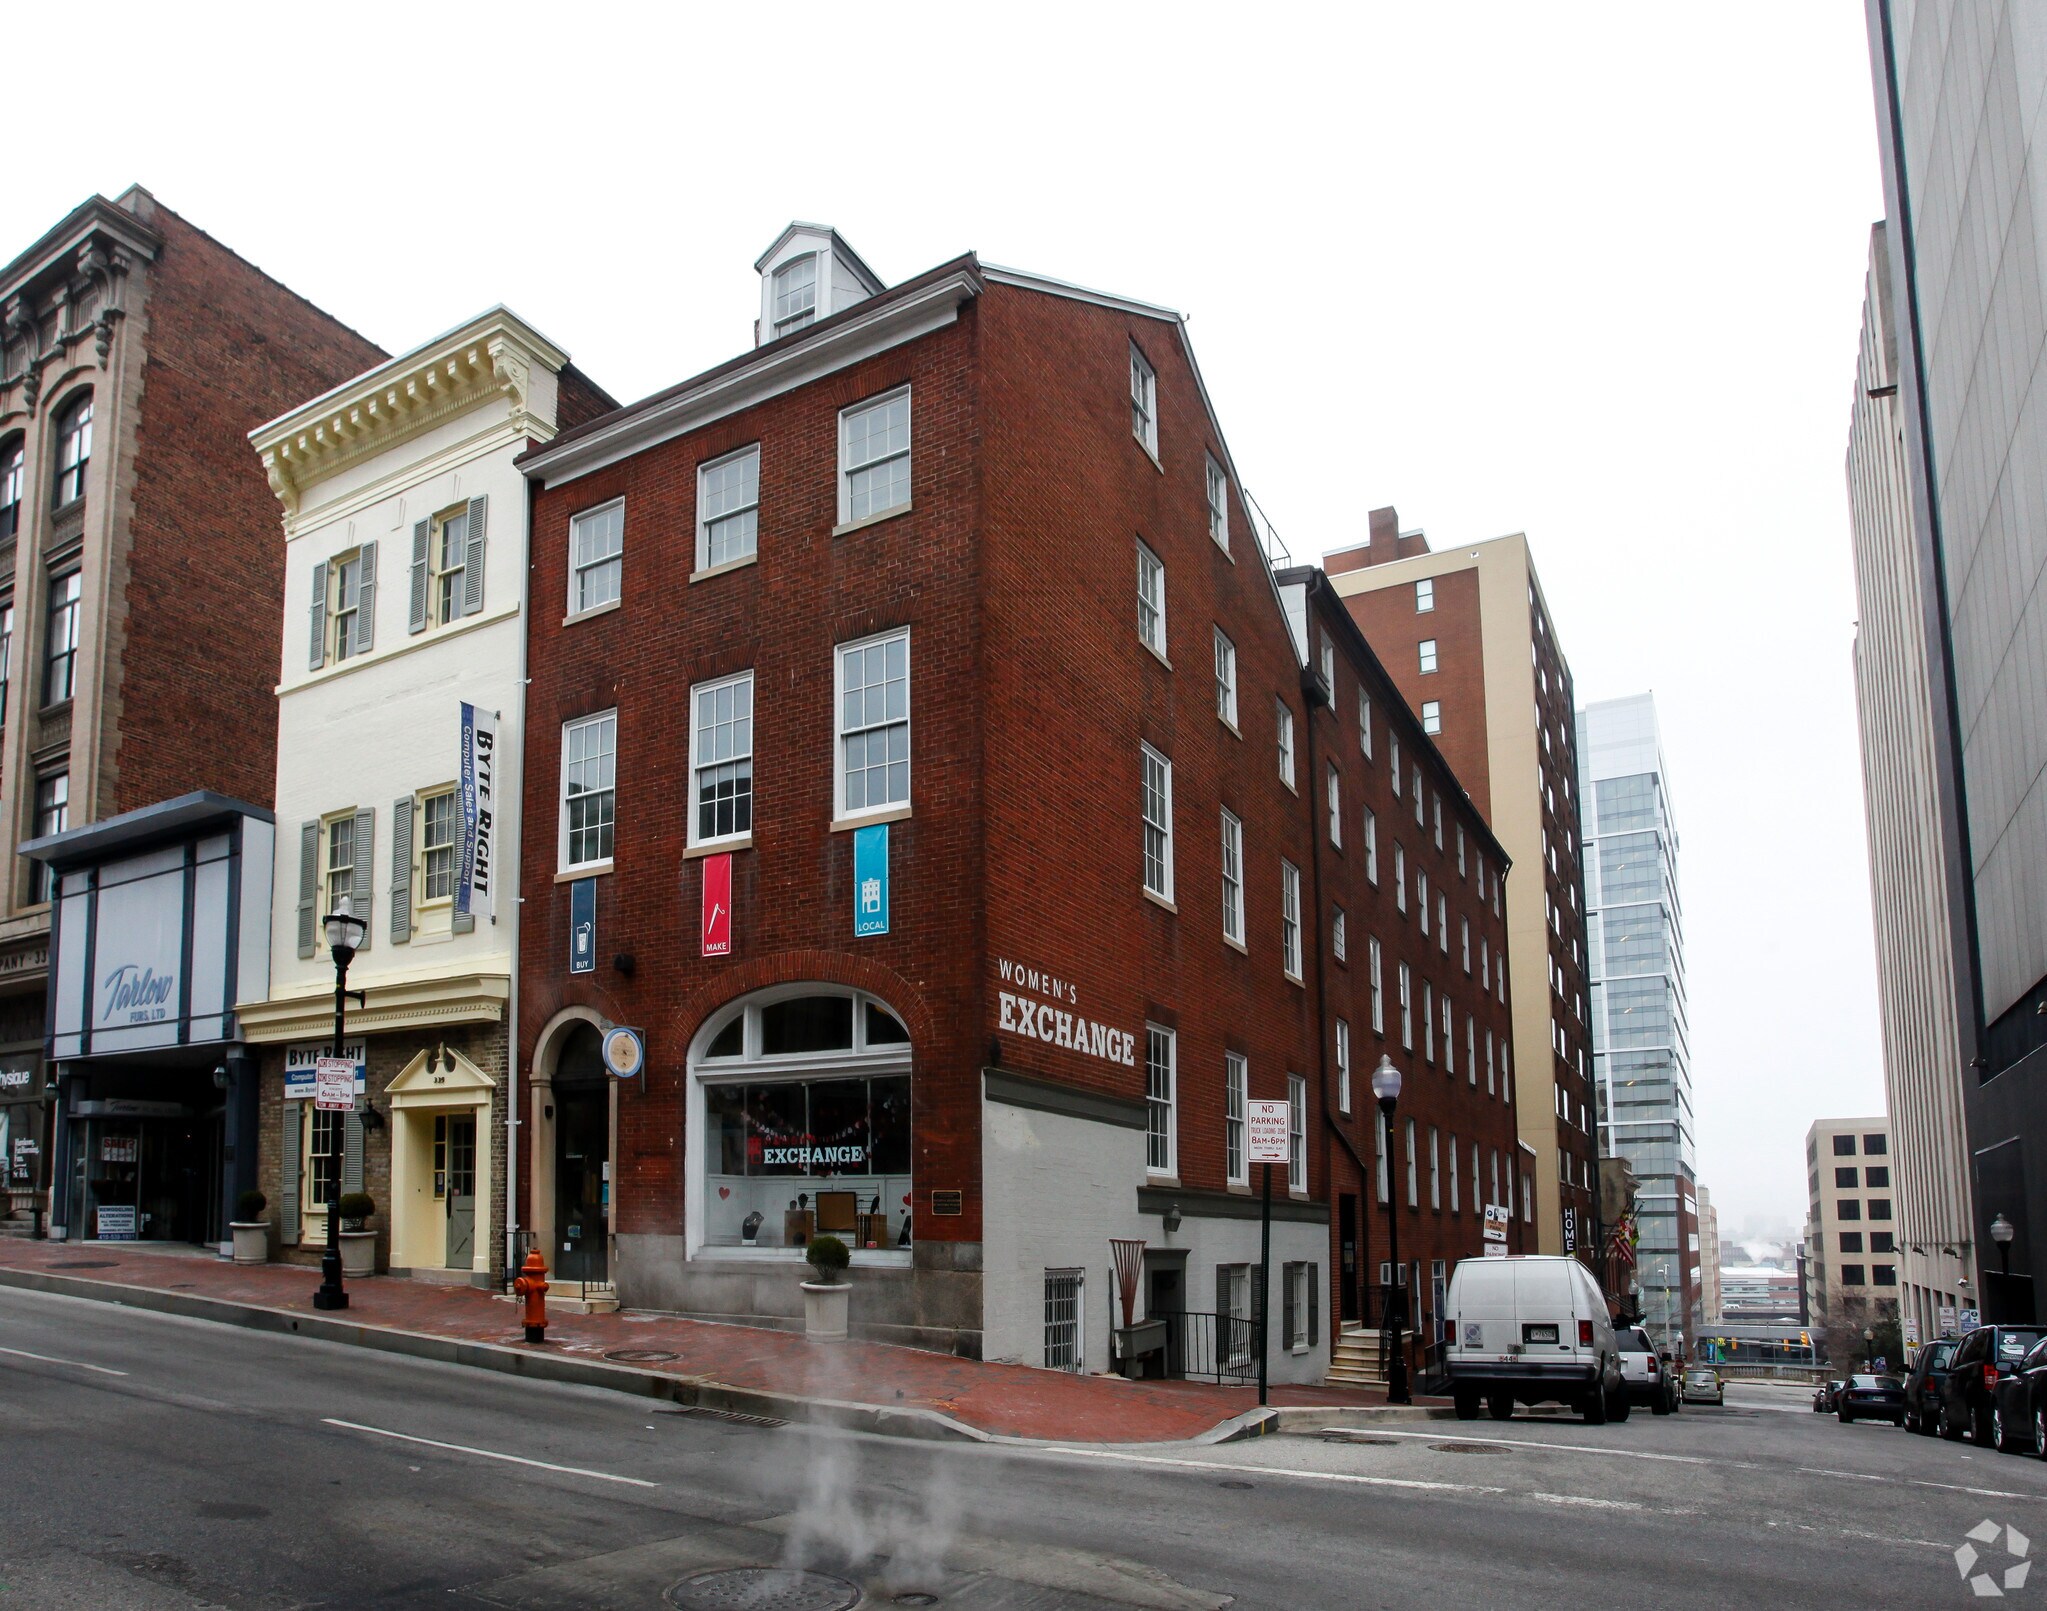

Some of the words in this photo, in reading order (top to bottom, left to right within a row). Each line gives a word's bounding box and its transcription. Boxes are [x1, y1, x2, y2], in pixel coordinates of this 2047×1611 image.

[462, 726, 472, 781] Computer
[476, 729, 494, 801] BYTE
[464, 784, 474, 814] Sales
[466, 816, 475, 838] and
[474, 809, 492, 896] RIGHT
[462, 840, 474, 885] Support
[858, 920, 885, 932] LOCAL
[706, 941, 727, 952] MAKE
[576, 960, 589, 969] BUY
[998, 957, 1077, 1005] WOMEN'S
[103, 964, 174, 1021] Tarlow
[151, 1008, 166, 1020] LTD
[998, 991, 1135, 1067] EXCHANGE
[289, 1049, 319, 1066] BYTE
[319, 1060, 327, 1068] NO
[327, 1060, 353, 1069] STOPPING
[291, 1073, 314, 1083] Computer
[319, 1074, 327, 1082] NO
[327, 1074, 353, 1083] STOPPING
[1262, 1105, 1274, 1113] NO
[1251, 1117, 1285, 1125] PARKING
[1251, 1136, 1286, 1145] 8AM-6PM
[763, 1146, 863, 1164] EXCHANGE
[1564, 1208, 1575, 1251] HOME
